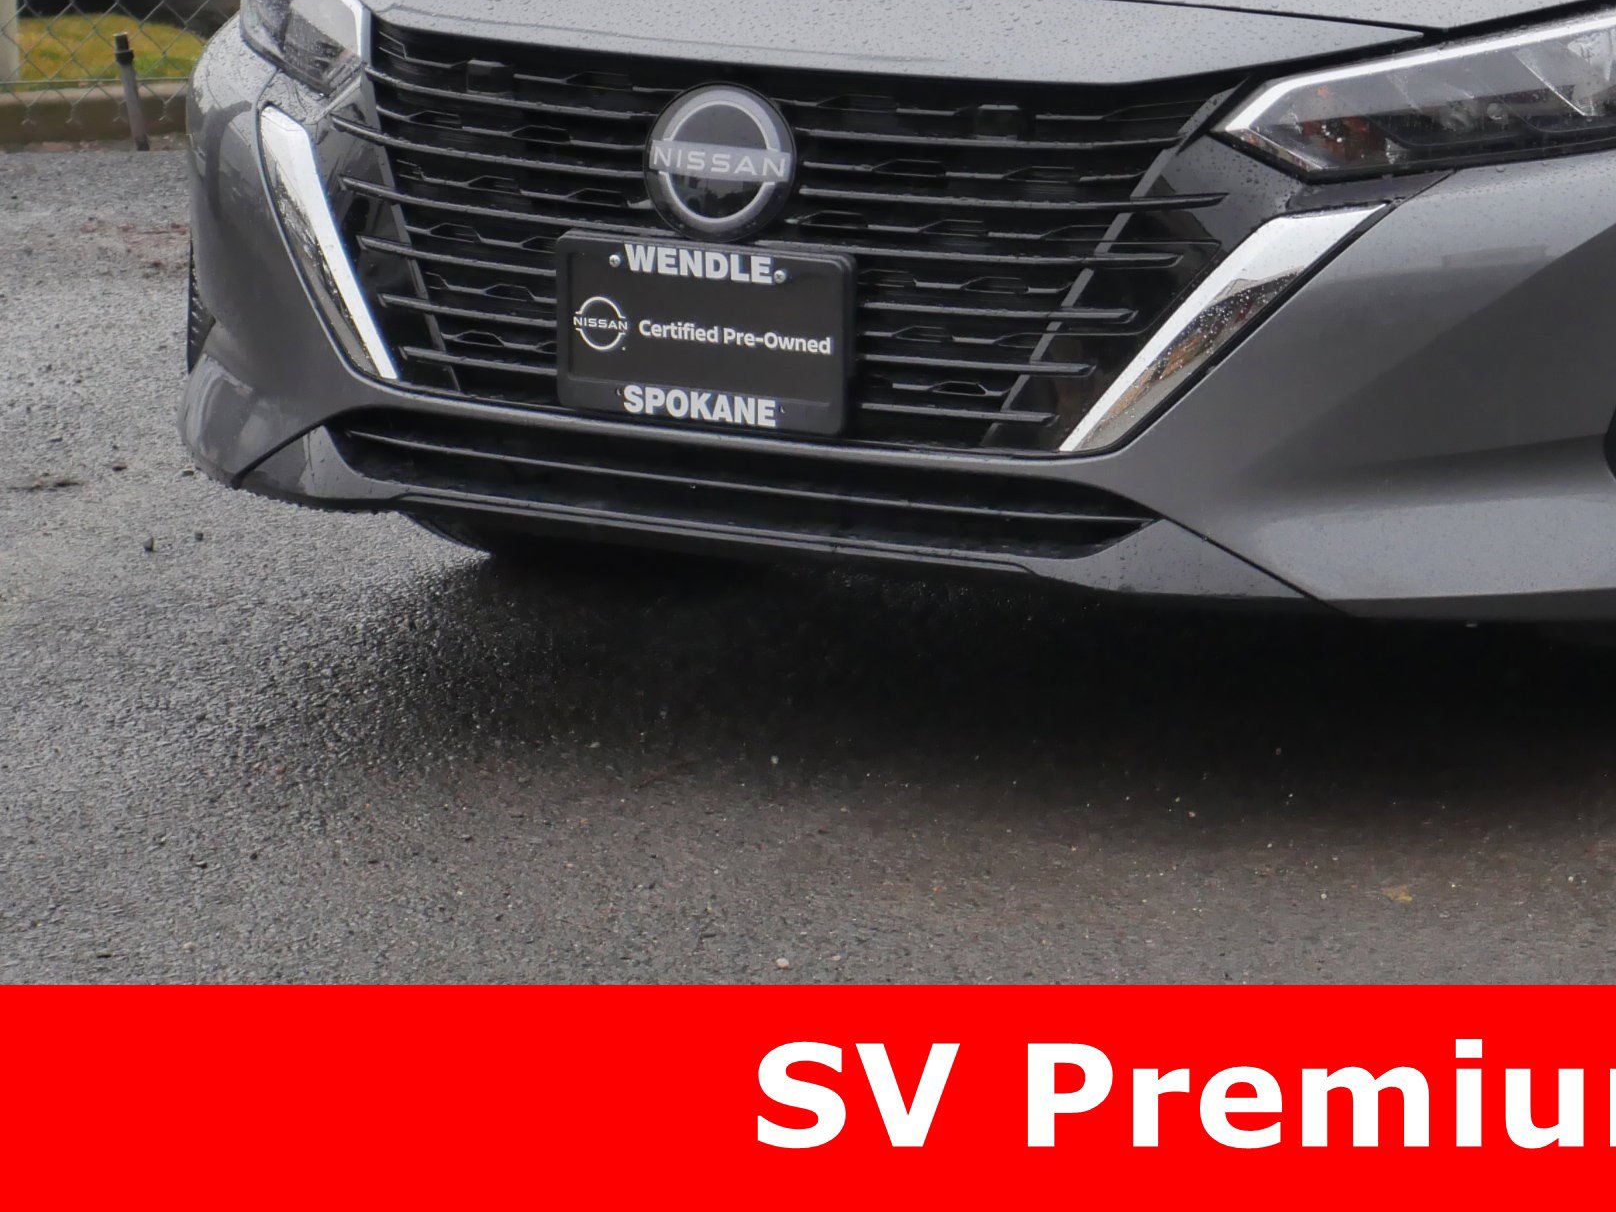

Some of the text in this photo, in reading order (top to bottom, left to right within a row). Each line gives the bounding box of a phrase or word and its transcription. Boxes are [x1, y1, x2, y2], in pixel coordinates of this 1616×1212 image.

[652, 147, 789, 178] NISSAN
[624, 243, 774, 284] WENDLE
[573, 315, 628, 331] NISSAN
[638, 319, 832, 355] Certified Pre-Owned
[623, 384, 777, 427] SPOKANE
